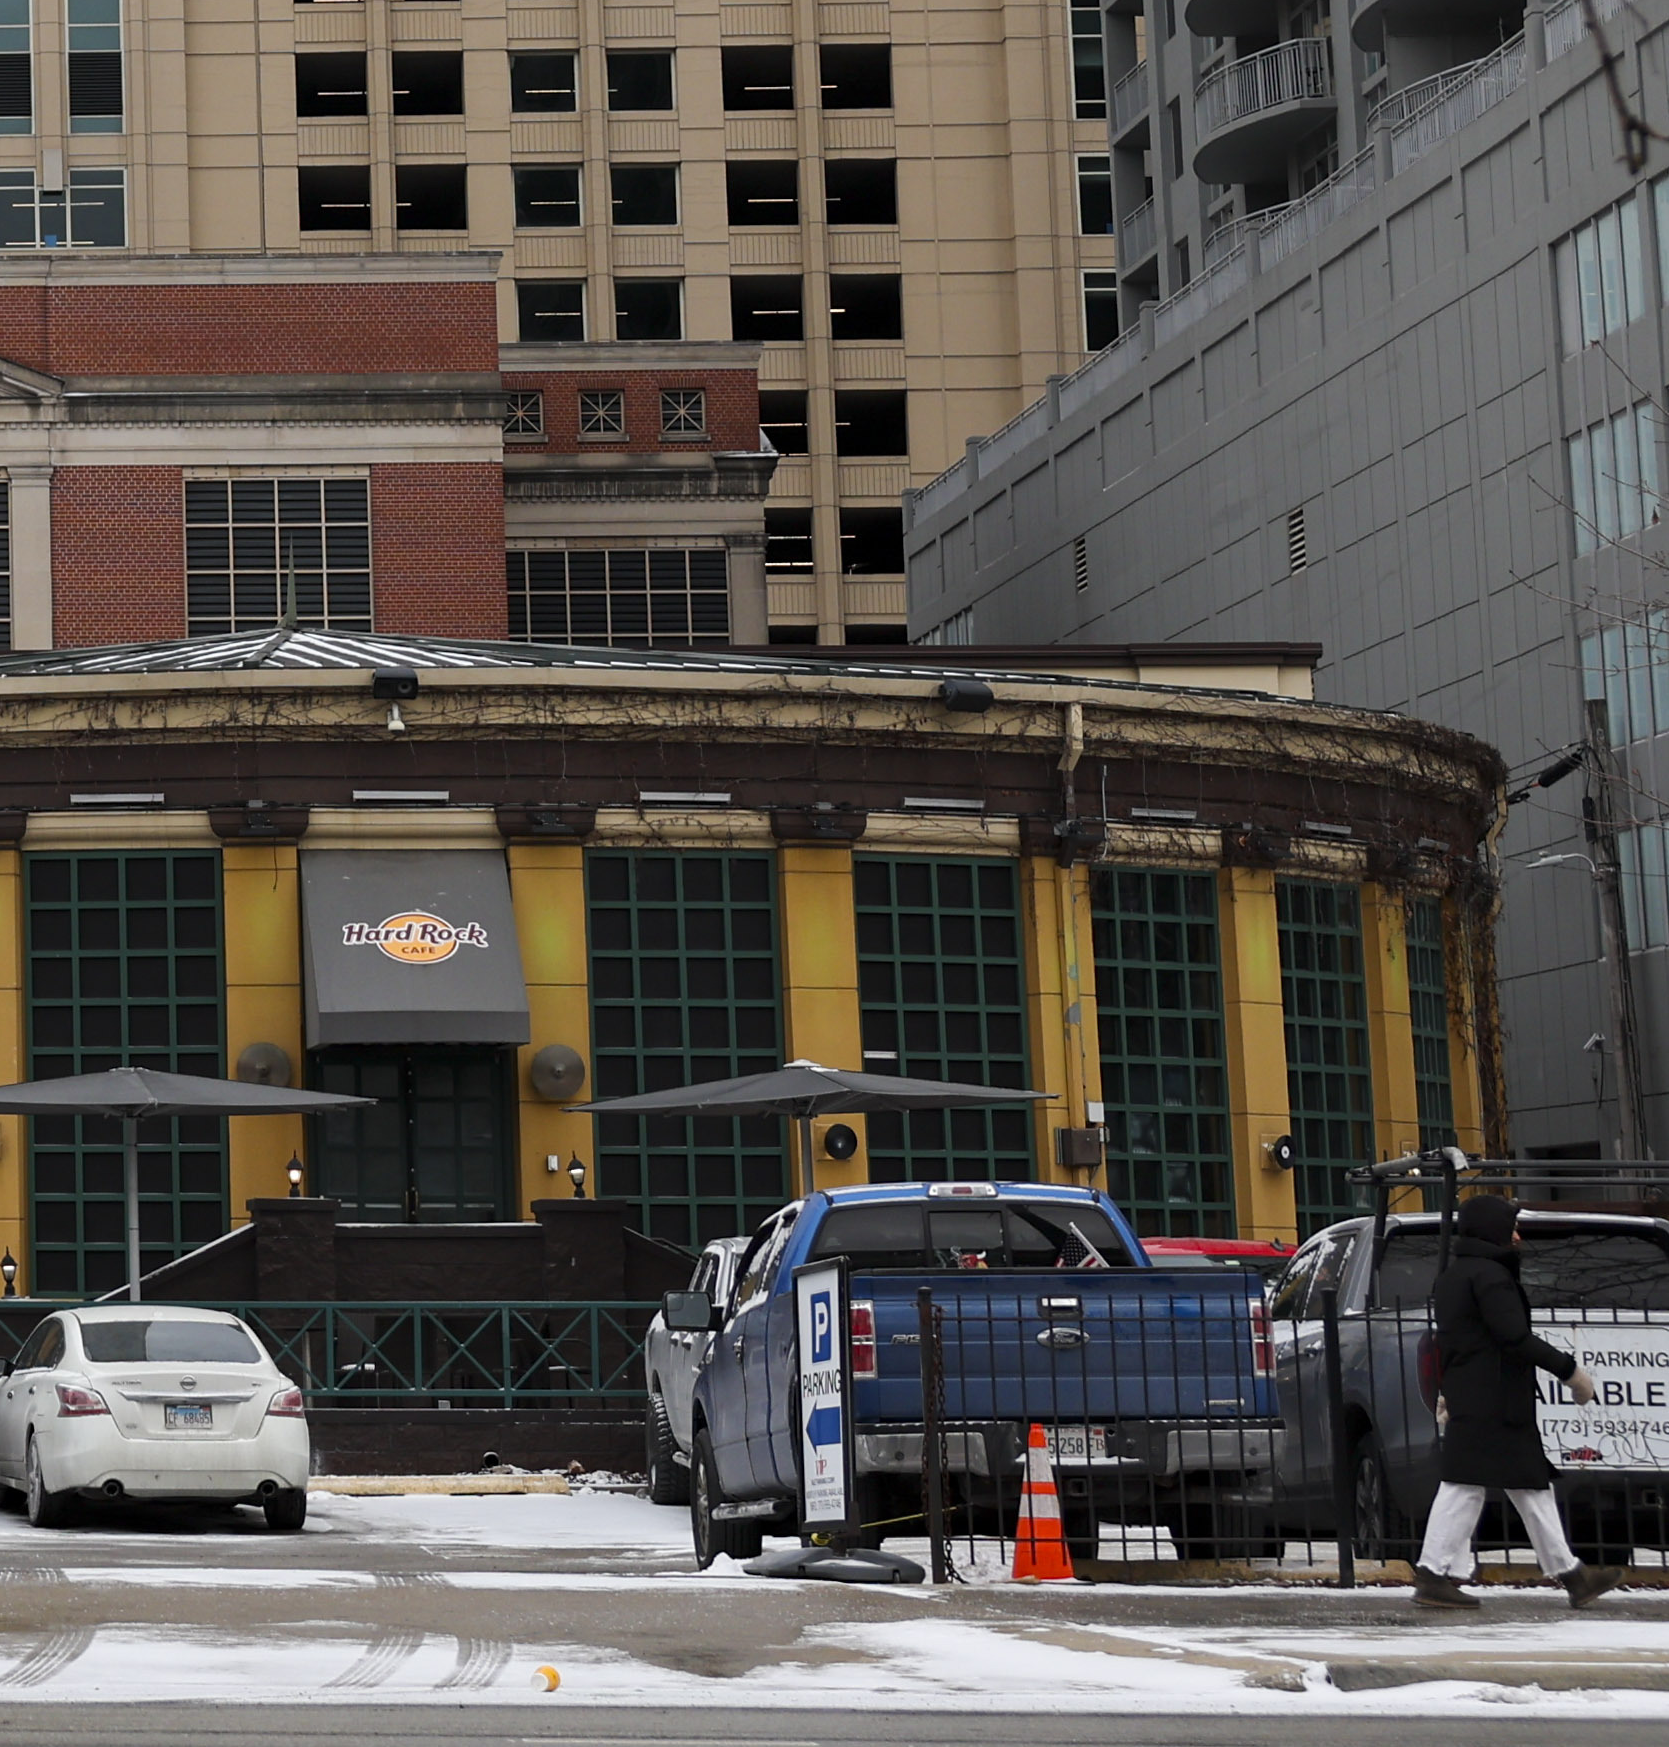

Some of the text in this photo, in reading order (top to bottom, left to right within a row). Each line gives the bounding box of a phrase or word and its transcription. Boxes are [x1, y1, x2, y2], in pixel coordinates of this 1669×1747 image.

[342, 922, 488, 947] Hard Rock
[401, 946, 436, 954] CAFE
[1583, 1351, 1669, 1367] PARKING
[803, 1368, 841, 1398] PARKING
